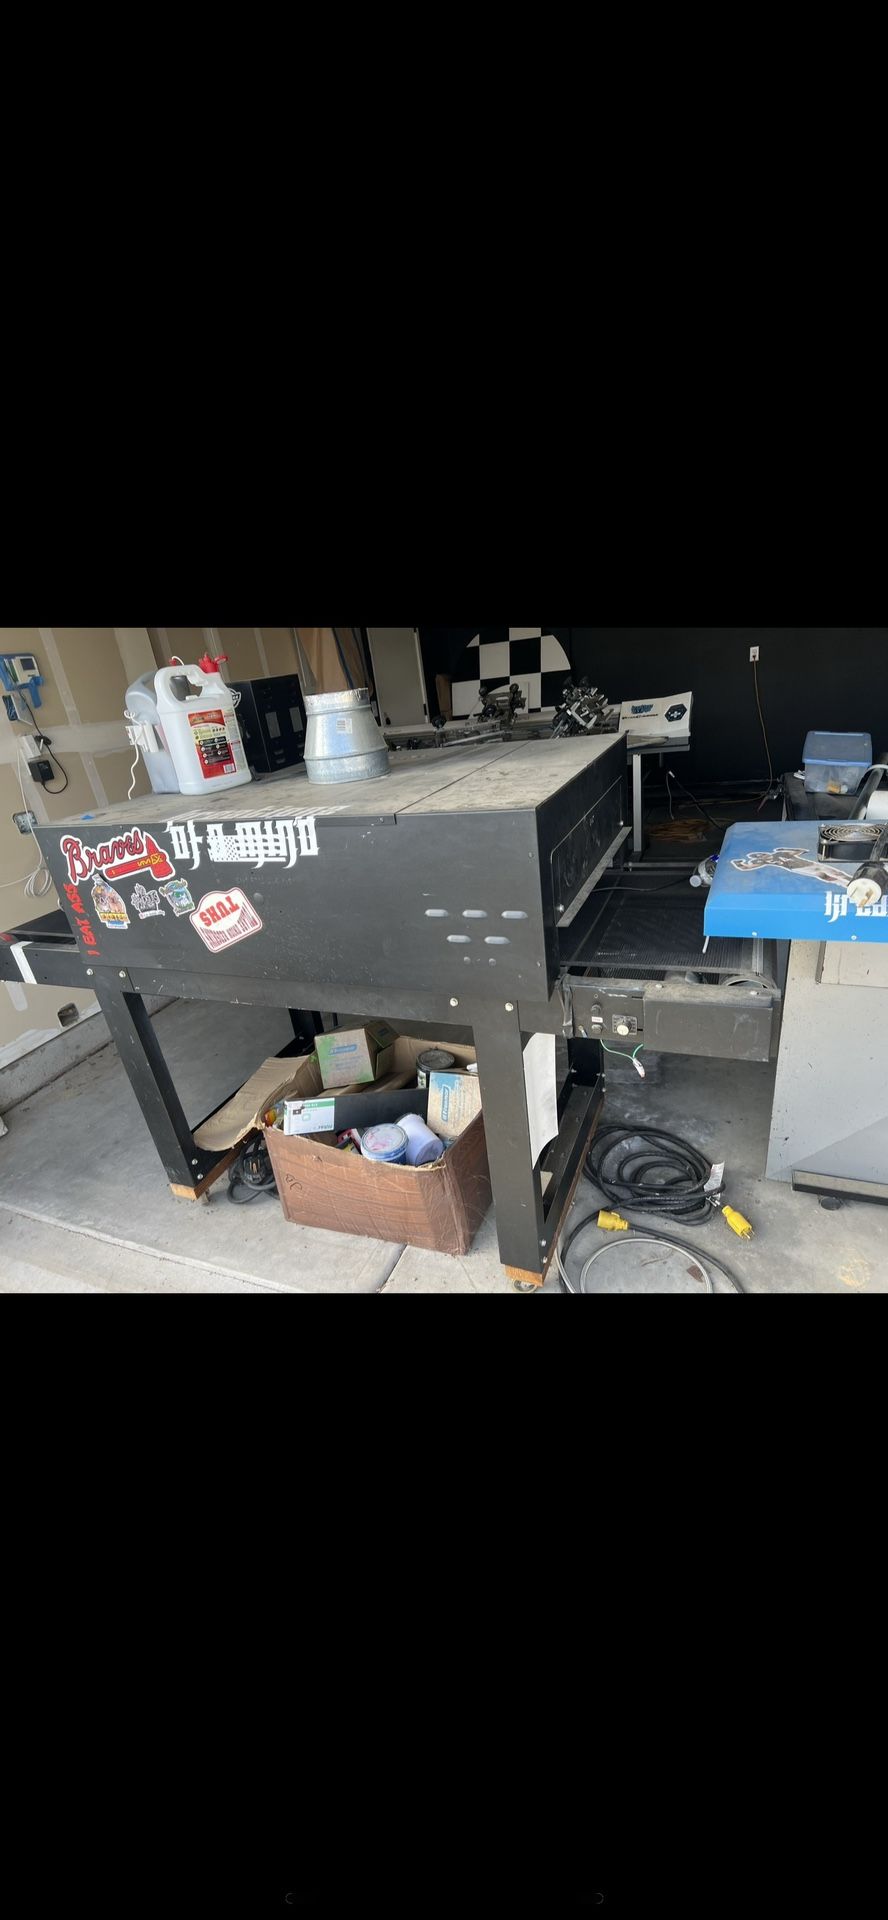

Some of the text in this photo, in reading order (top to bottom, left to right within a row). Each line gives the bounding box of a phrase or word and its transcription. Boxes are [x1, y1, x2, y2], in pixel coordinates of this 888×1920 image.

[62, 829, 143, 882] Braves
[63, 883, 86, 914] ASS
[200, 895, 240, 927] TUHS
[75, 918, 97, 947] EAT
